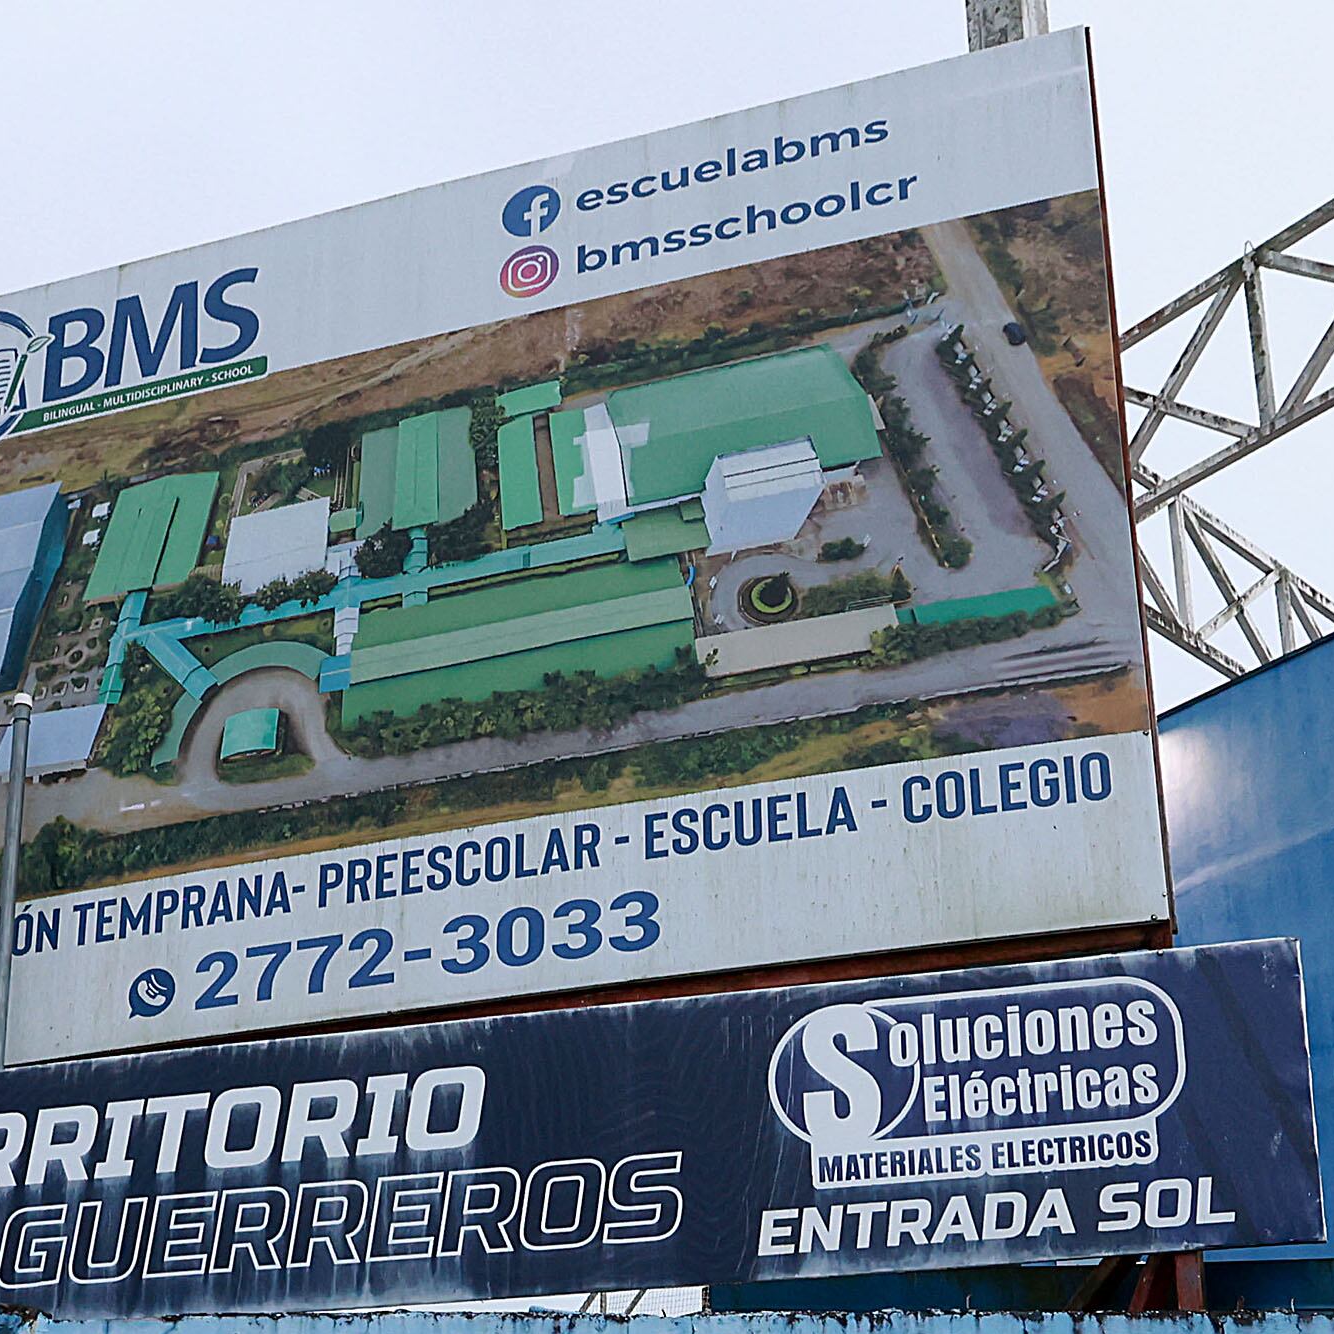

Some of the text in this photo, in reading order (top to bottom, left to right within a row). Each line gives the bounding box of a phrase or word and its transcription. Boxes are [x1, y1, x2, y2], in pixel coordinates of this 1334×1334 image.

[575, 118, 890, 213] escuelabms
[576, 174, 918, 274] bmsschoolcr
[40, 266, 260, 403] BMS
[42, 402, 96, 423] BILINGUAL
[102, 376, 203, 411] MULTIDISCIPLINARY
[210, 364, 254, 387] SCHOOL
[317, 822, 601, 908] PREESCOLAR
[643, 786, 858, 861] ESCUELA
[902, 750, 1113, 825] COLEGIO
[194, 889, 662, 1011] 2772-3033
[922, 1061, 1160, 1123] Eléctricas
[818, 1129, 1153, 1184] MATERIALES ELECTRICOS
[757, 1176, 1237, 1257] ENTRADA SOL
